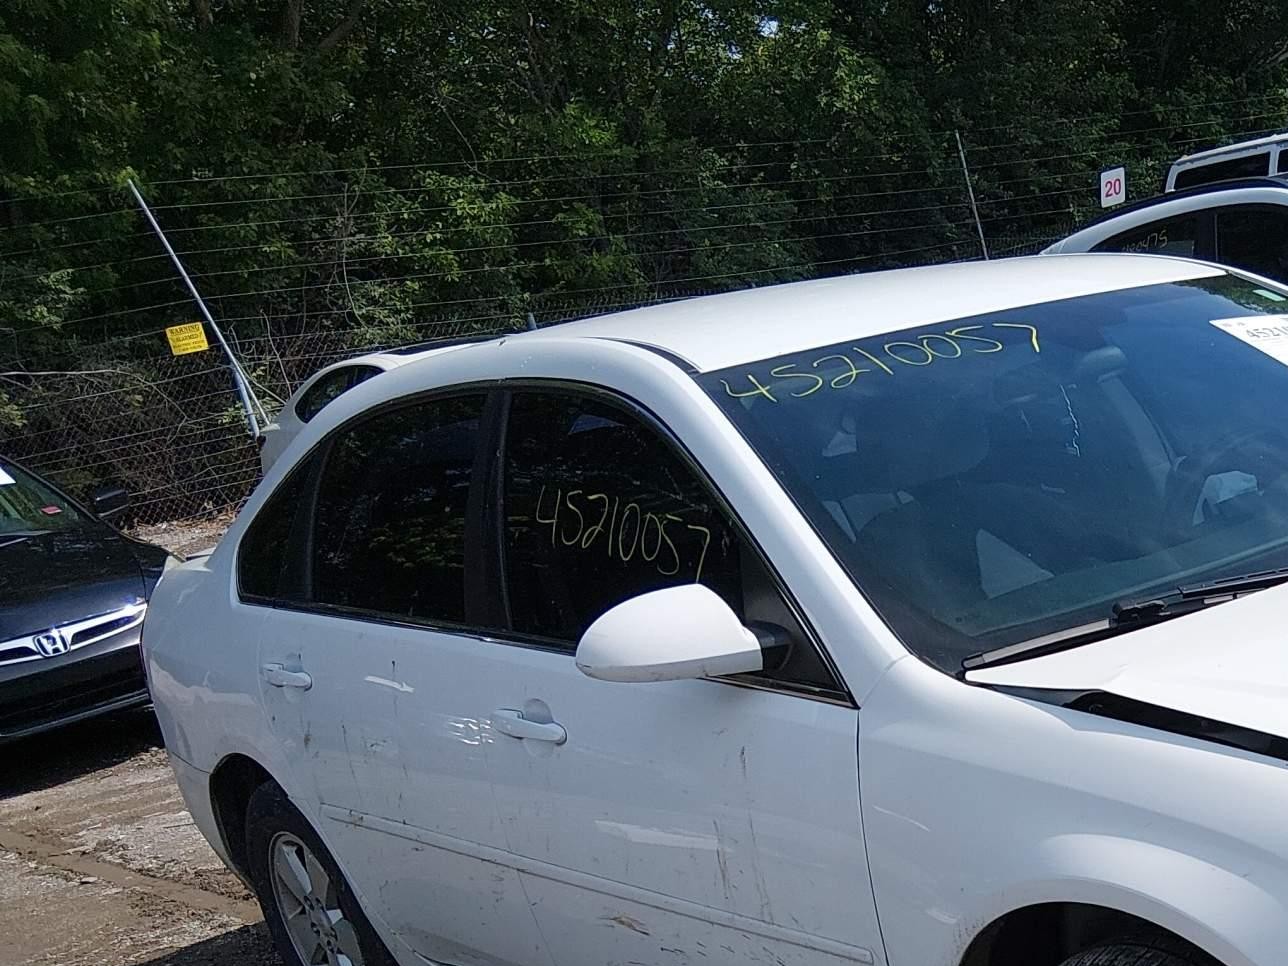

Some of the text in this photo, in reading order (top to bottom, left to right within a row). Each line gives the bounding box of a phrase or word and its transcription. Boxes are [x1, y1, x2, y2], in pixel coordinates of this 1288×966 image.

[1105, 178, 1121, 197] 20
[169, 323, 201, 335] WARNING
[720, 323, 1040, 402] 45210057
[536, 485, 711, 584] 45210057
